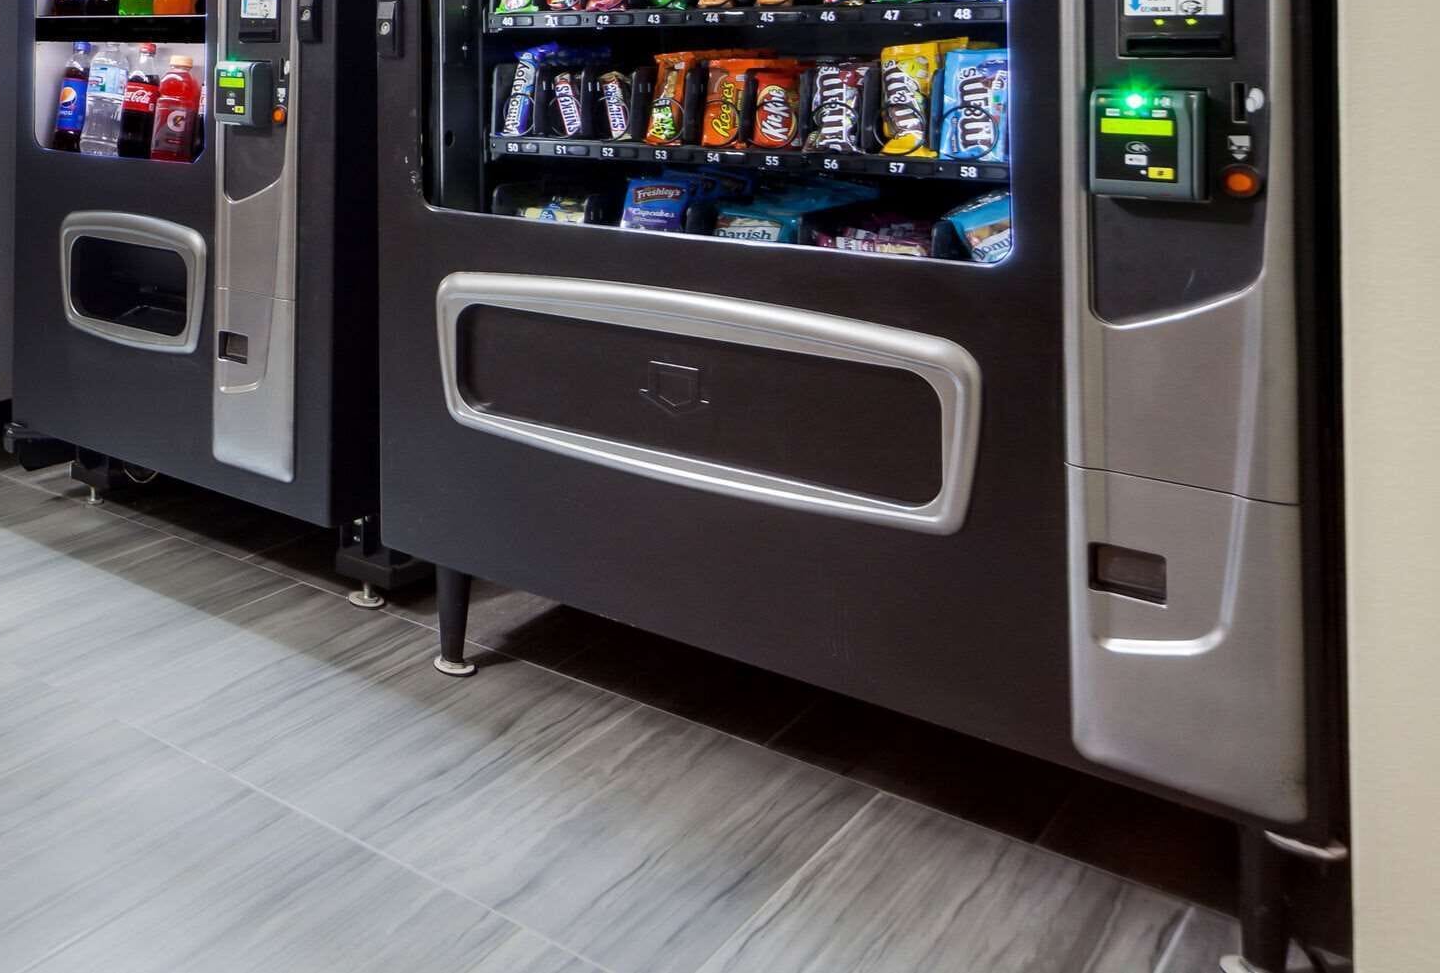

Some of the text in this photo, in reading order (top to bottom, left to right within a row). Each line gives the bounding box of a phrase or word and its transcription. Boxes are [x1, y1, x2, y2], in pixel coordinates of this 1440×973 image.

[706, 12, 719, 23] 44
[760, 12, 774, 22] 45
[820, 11, 835, 22] 46
[884, 10, 900, 21] 47
[954, 8, 972, 19] 48
[597, 16, 609, 25] 42
[648, 14, 660, 24] 43
[167, 111, 187, 132] G
[508, 143, 518, 152] 50
[556, 145, 566, 154] 51
[602, 148, 614, 157] 52
[655, 150, 667, 160] 53
[707, 153, 720, 163] 54
[765, 156, 779, 166] 55
[824, 159, 838, 170] 56
[890, 162, 904, 173] 57
[960, 166, 977, 178] 58
[717, 228, 772, 241] Danish
